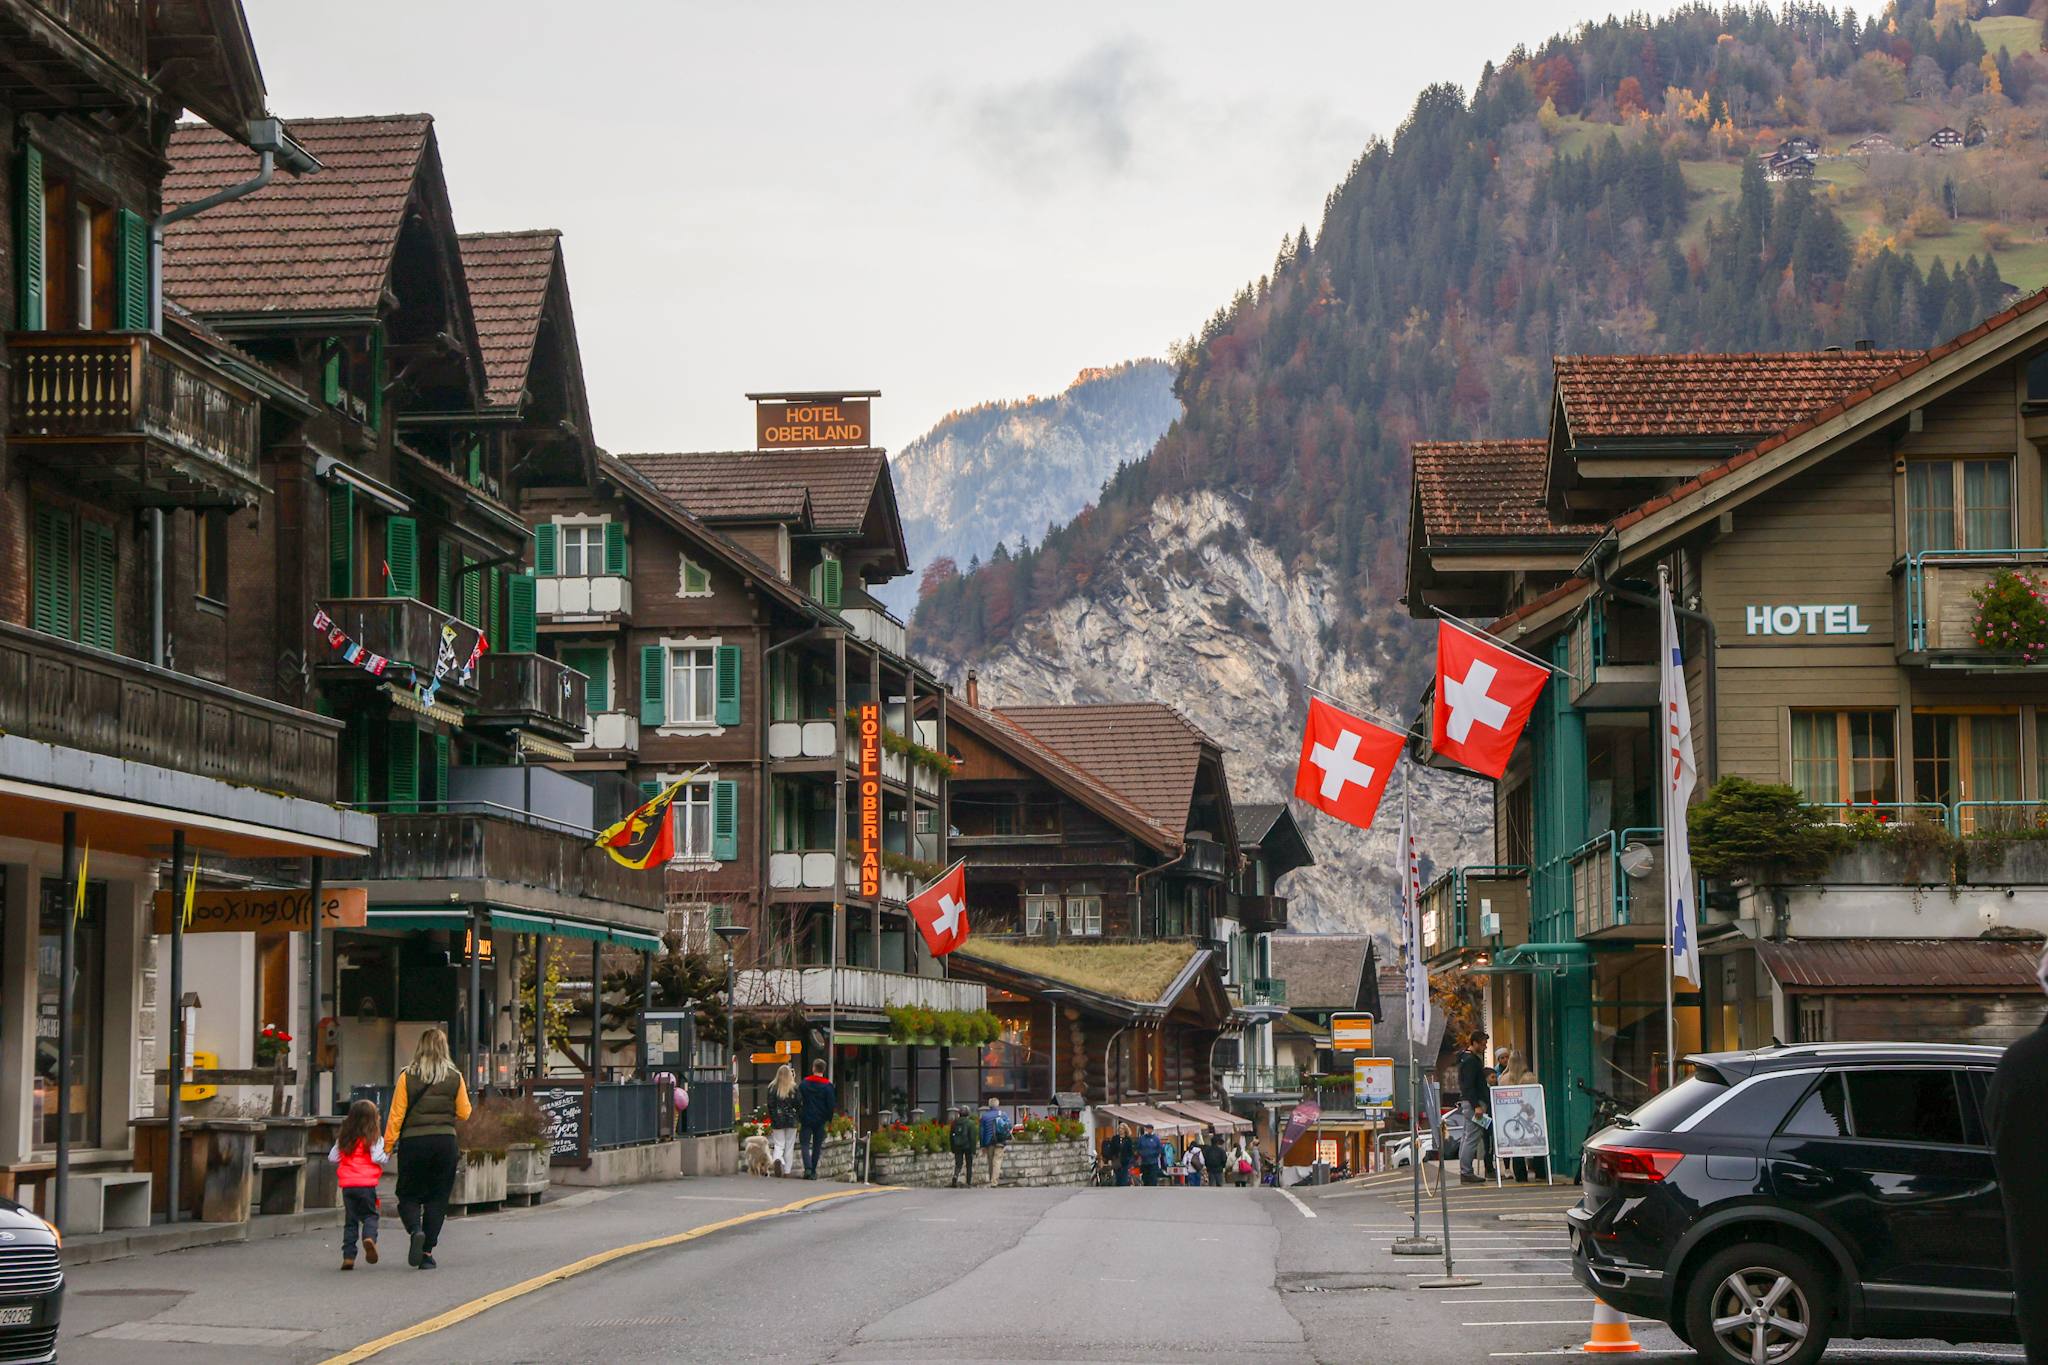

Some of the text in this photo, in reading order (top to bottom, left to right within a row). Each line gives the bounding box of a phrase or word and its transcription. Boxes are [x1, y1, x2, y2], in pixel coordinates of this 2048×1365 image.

[786, 407, 845, 423] HOTEL
[765, 425, 862, 442] OBERLAND
[1746, 605, 1871, 635] HOTEL
[862, 705, 878, 896] HOTEL OBERLAND
